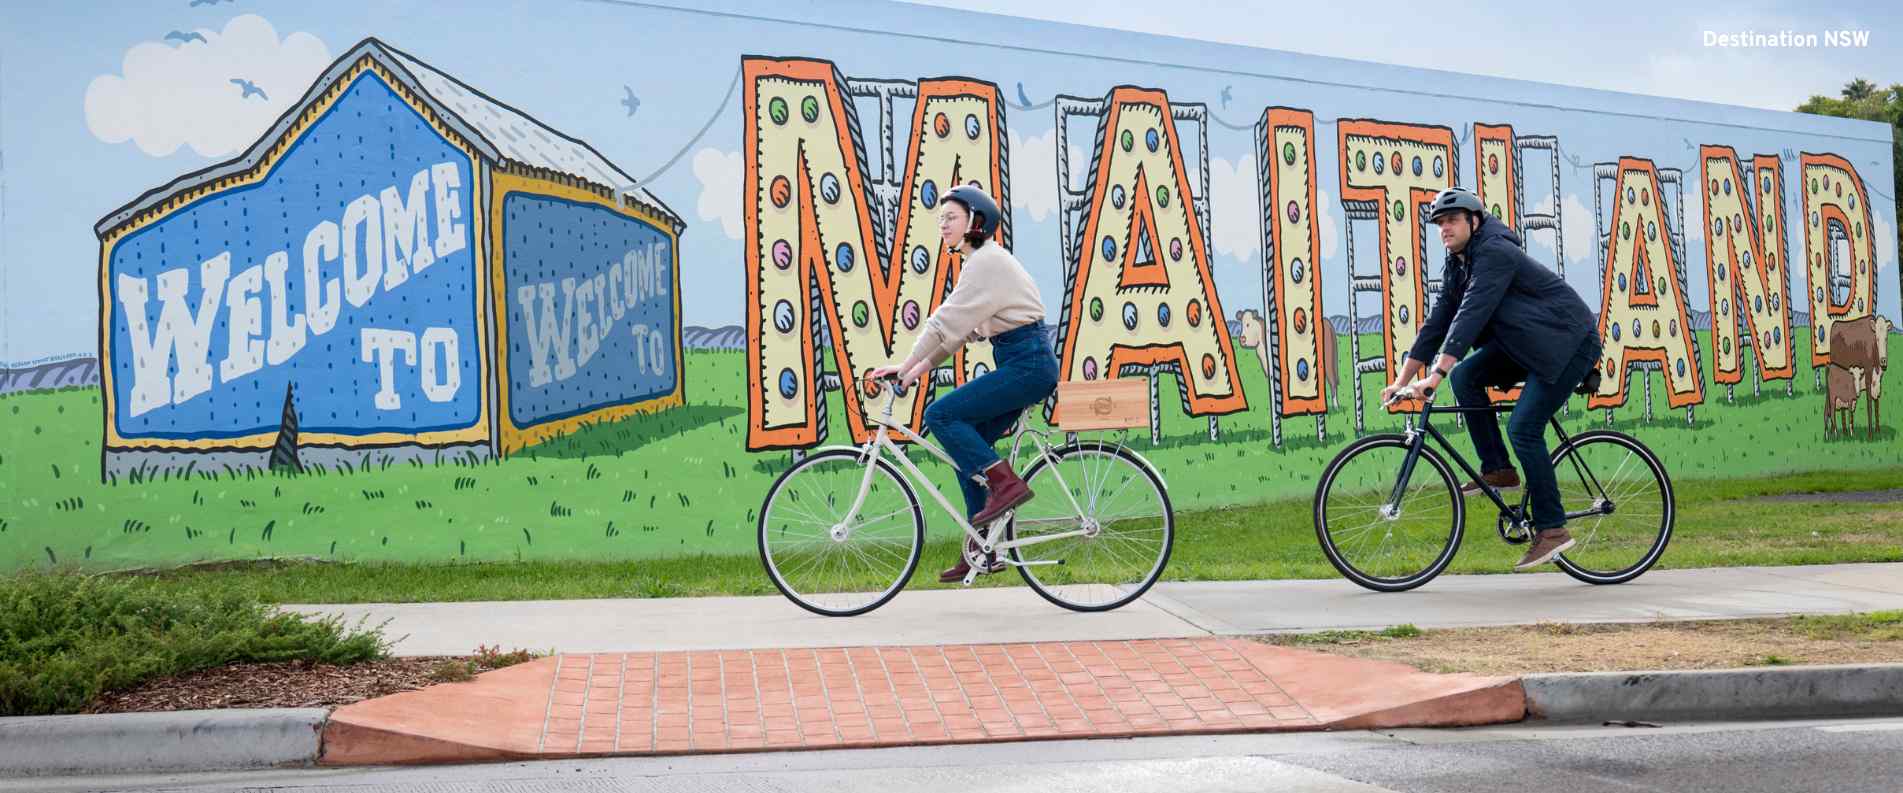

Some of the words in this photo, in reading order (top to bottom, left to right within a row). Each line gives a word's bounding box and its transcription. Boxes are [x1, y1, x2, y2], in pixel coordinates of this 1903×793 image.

[118, 162, 466, 418] WELCOME
[517, 242, 667, 388] WELCOME
[361, 327, 461, 411] TO
[631, 323, 665, 377] TO
